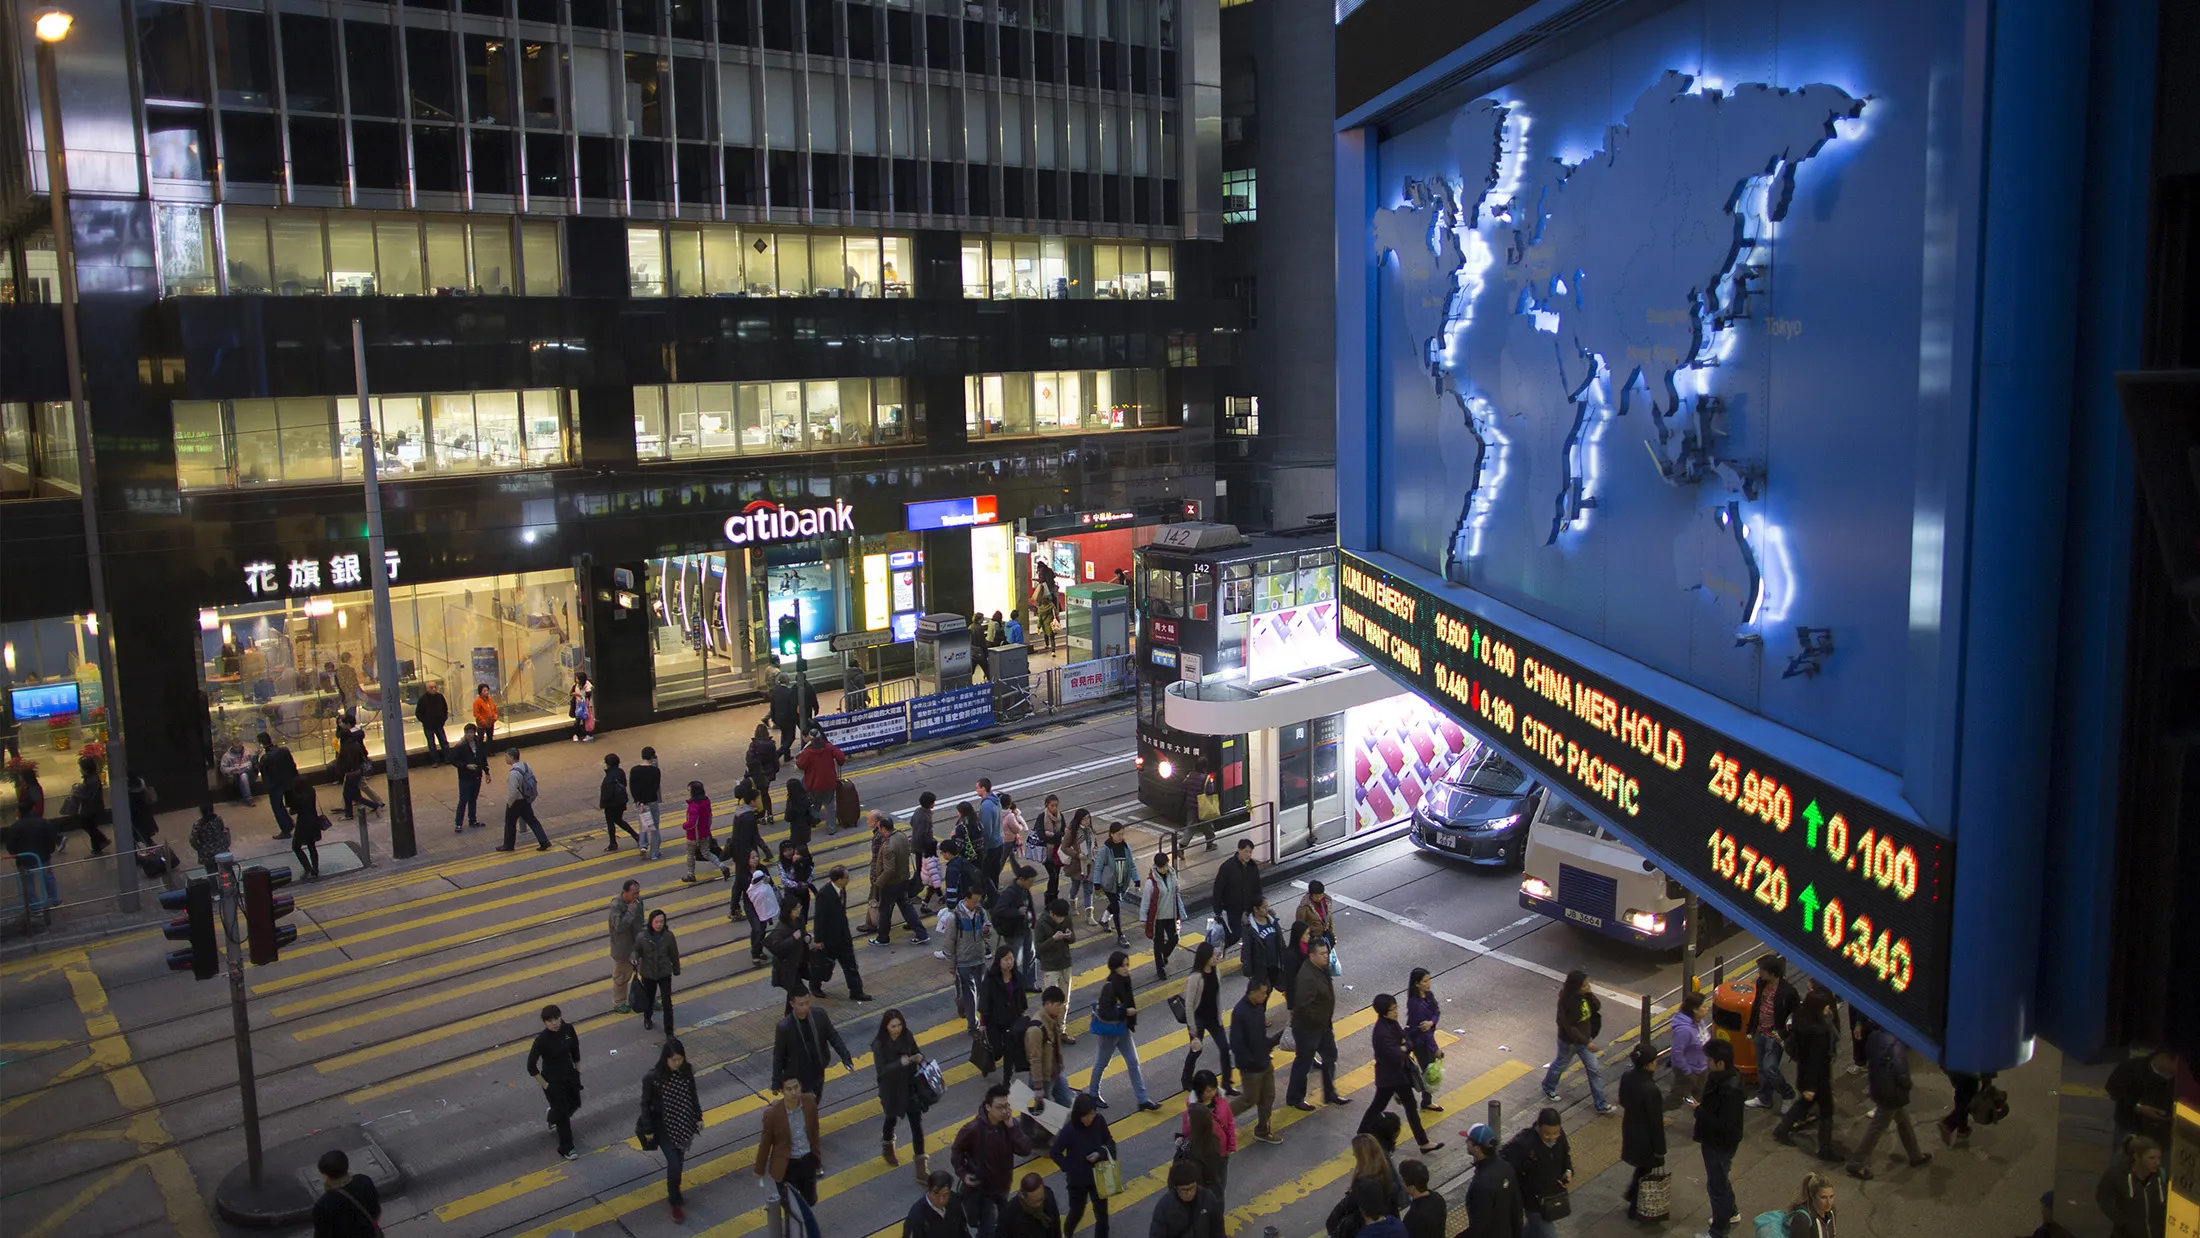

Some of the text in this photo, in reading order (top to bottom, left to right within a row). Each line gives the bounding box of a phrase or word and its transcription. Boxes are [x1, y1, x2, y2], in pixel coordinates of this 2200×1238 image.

[1764, 317, 1802, 340] Tokyo
[724, 497, 855, 544] citibank
[1163, 528, 1191, 546] 142
[1193, 563, 1210, 573] 142
[1342, 564, 1377, 605] KUNLUN
[1376, 581, 1417, 623] ENERGY
[1481, 635, 1516, 679] 0.100
[1522, 657, 1572, 711] CHINA
[1574, 682, 1619, 738] MER
[1621, 706, 1686, 771] HOLD
[1708, 750, 1793, 833] 25.950
[1826, 811, 1919, 900] 0.100
[1342, 603, 1914, 993] WANT WANT CHINA 10.440 0.180 CITIC PACIFIC 13.720 0.340
[1566, 909, 1601, 927] JB 3664
